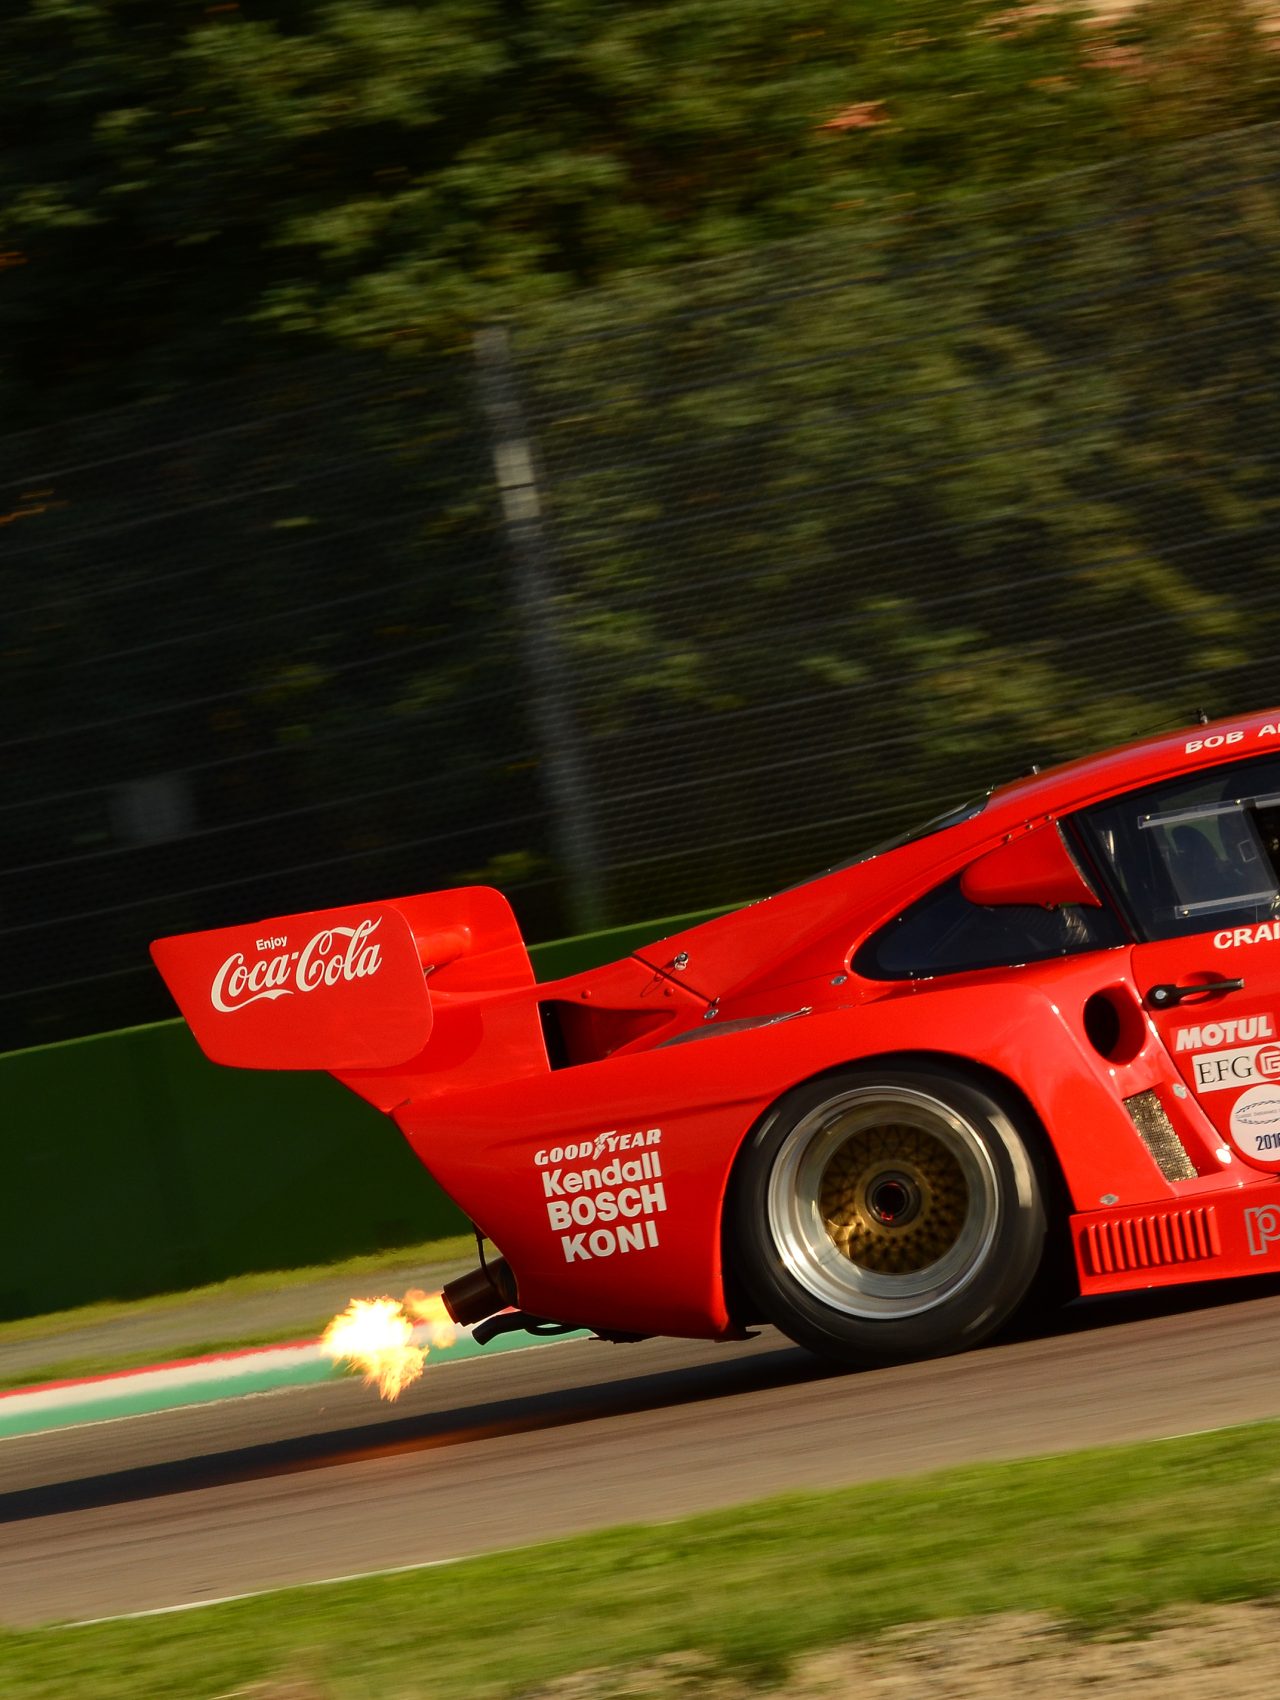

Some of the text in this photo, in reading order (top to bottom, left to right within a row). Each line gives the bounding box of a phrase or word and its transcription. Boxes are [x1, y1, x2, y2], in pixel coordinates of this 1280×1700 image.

[1185, 731, 1244, 754] BOB
[256, 936, 288, 951] Enjoy
[211, 916, 383, 1013] Coca-Cola
[1175, 1015, 1273, 1051] MOTUL
[1196, 1056, 1252, 1085] EFG
[534, 1128, 662, 1166] GOODYEAR
[541, 1151, 662, 1198] Kendall
[546, 1182, 667, 1231] BOSCH
[561, 1220, 659, 1263] KONI
